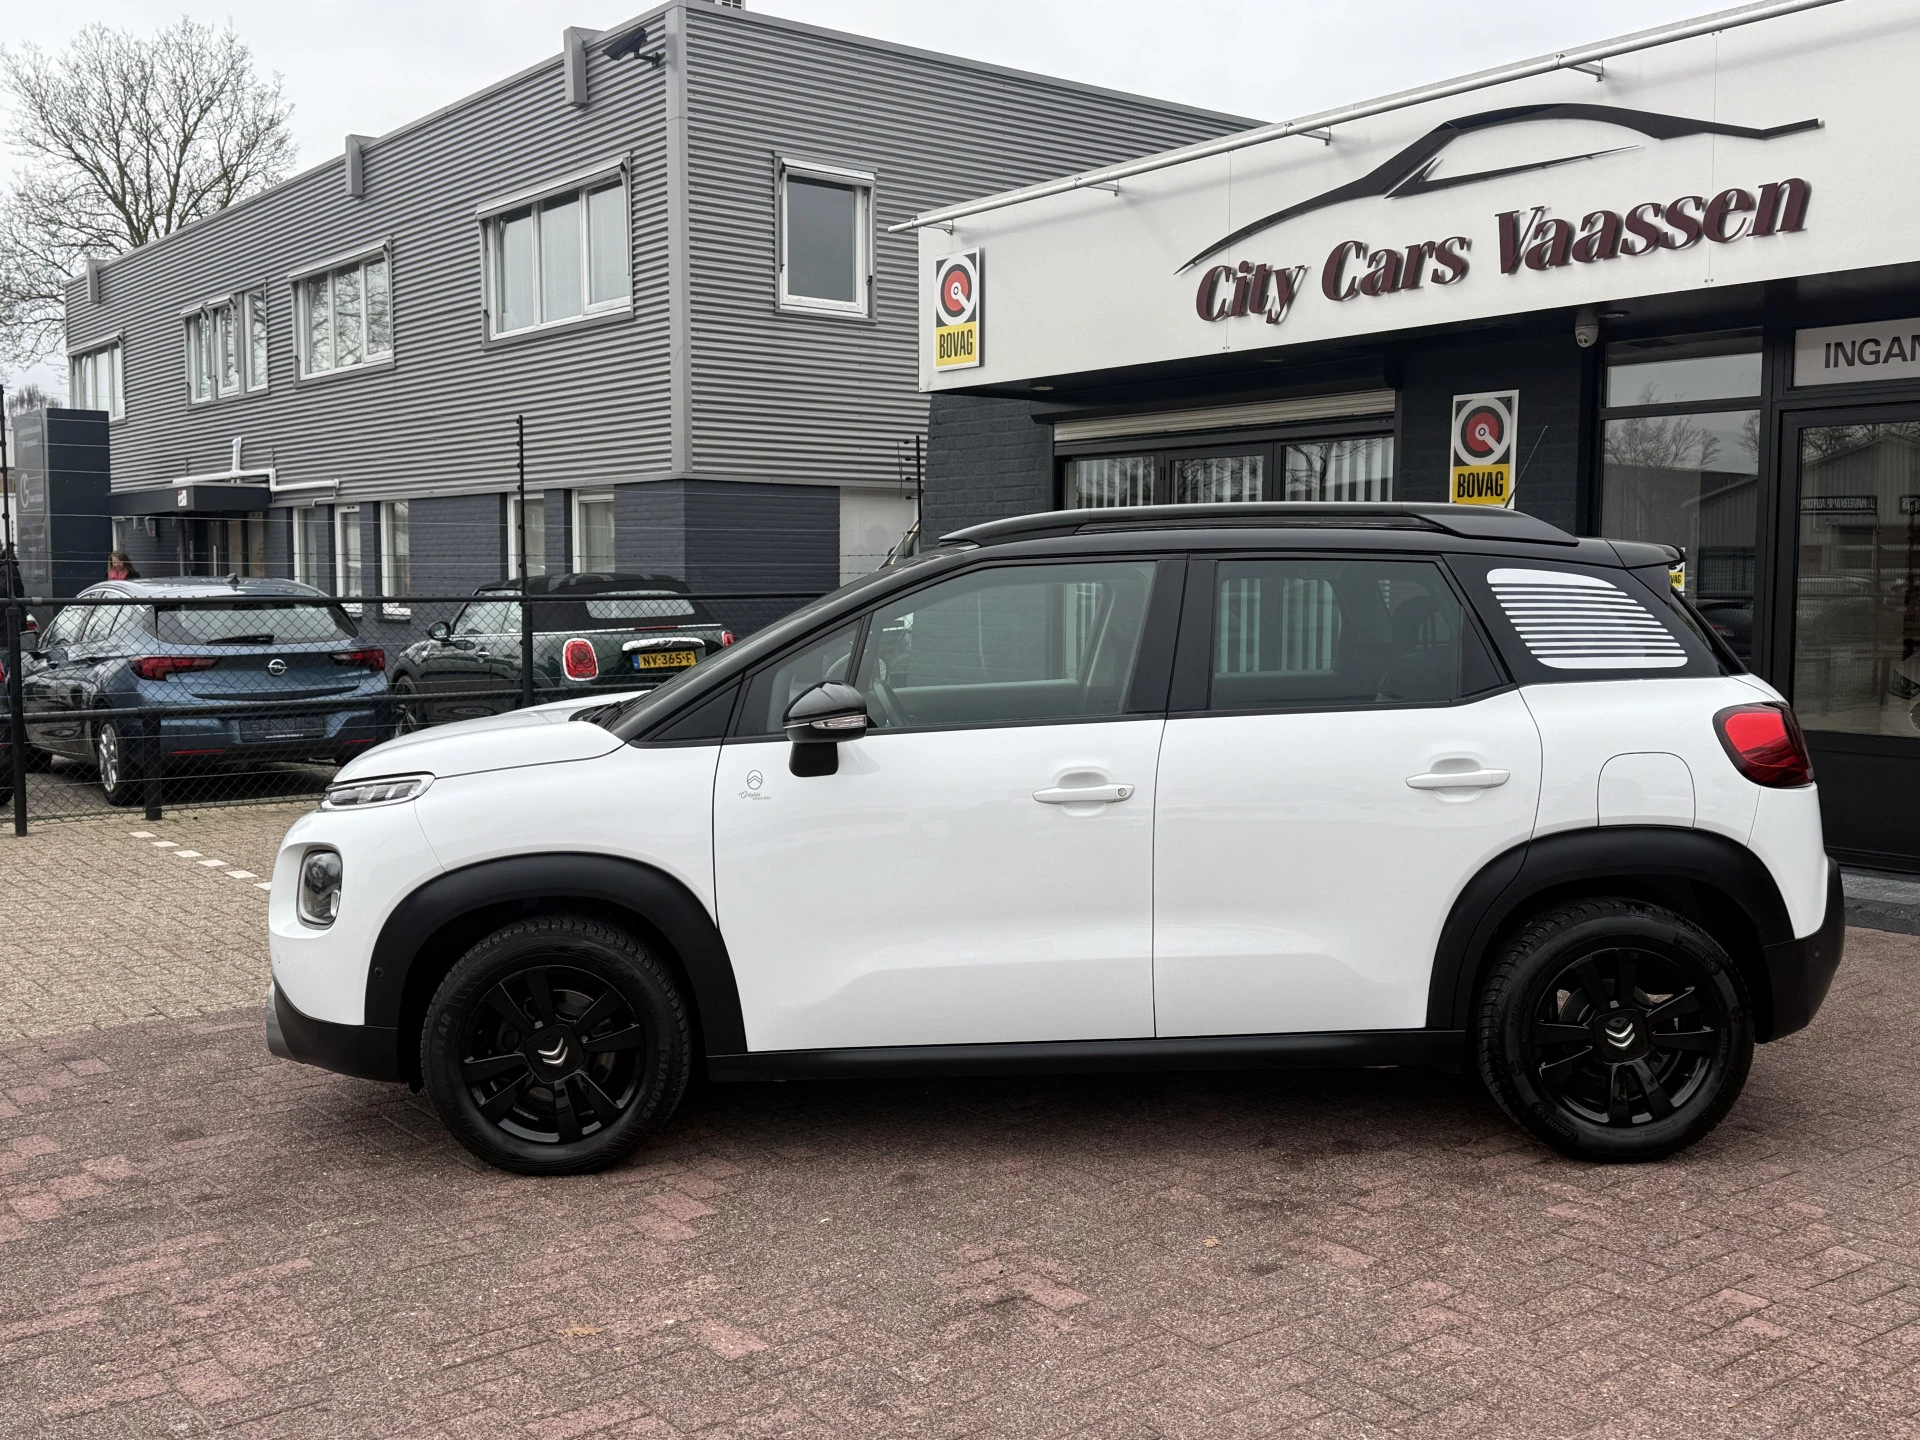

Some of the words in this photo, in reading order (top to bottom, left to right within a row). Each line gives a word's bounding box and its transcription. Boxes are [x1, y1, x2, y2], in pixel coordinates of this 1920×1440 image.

[1196, 261, 1304, 325] City
[1321, 240, 1468, 302] Cars
[1496, 176, 1808, 274] Vaassen
[940, 329, 973, 359] BOVAG
[1457, 471, 1504, 498] BOVAG
[642, 653, 692, 667] NV-365-F
